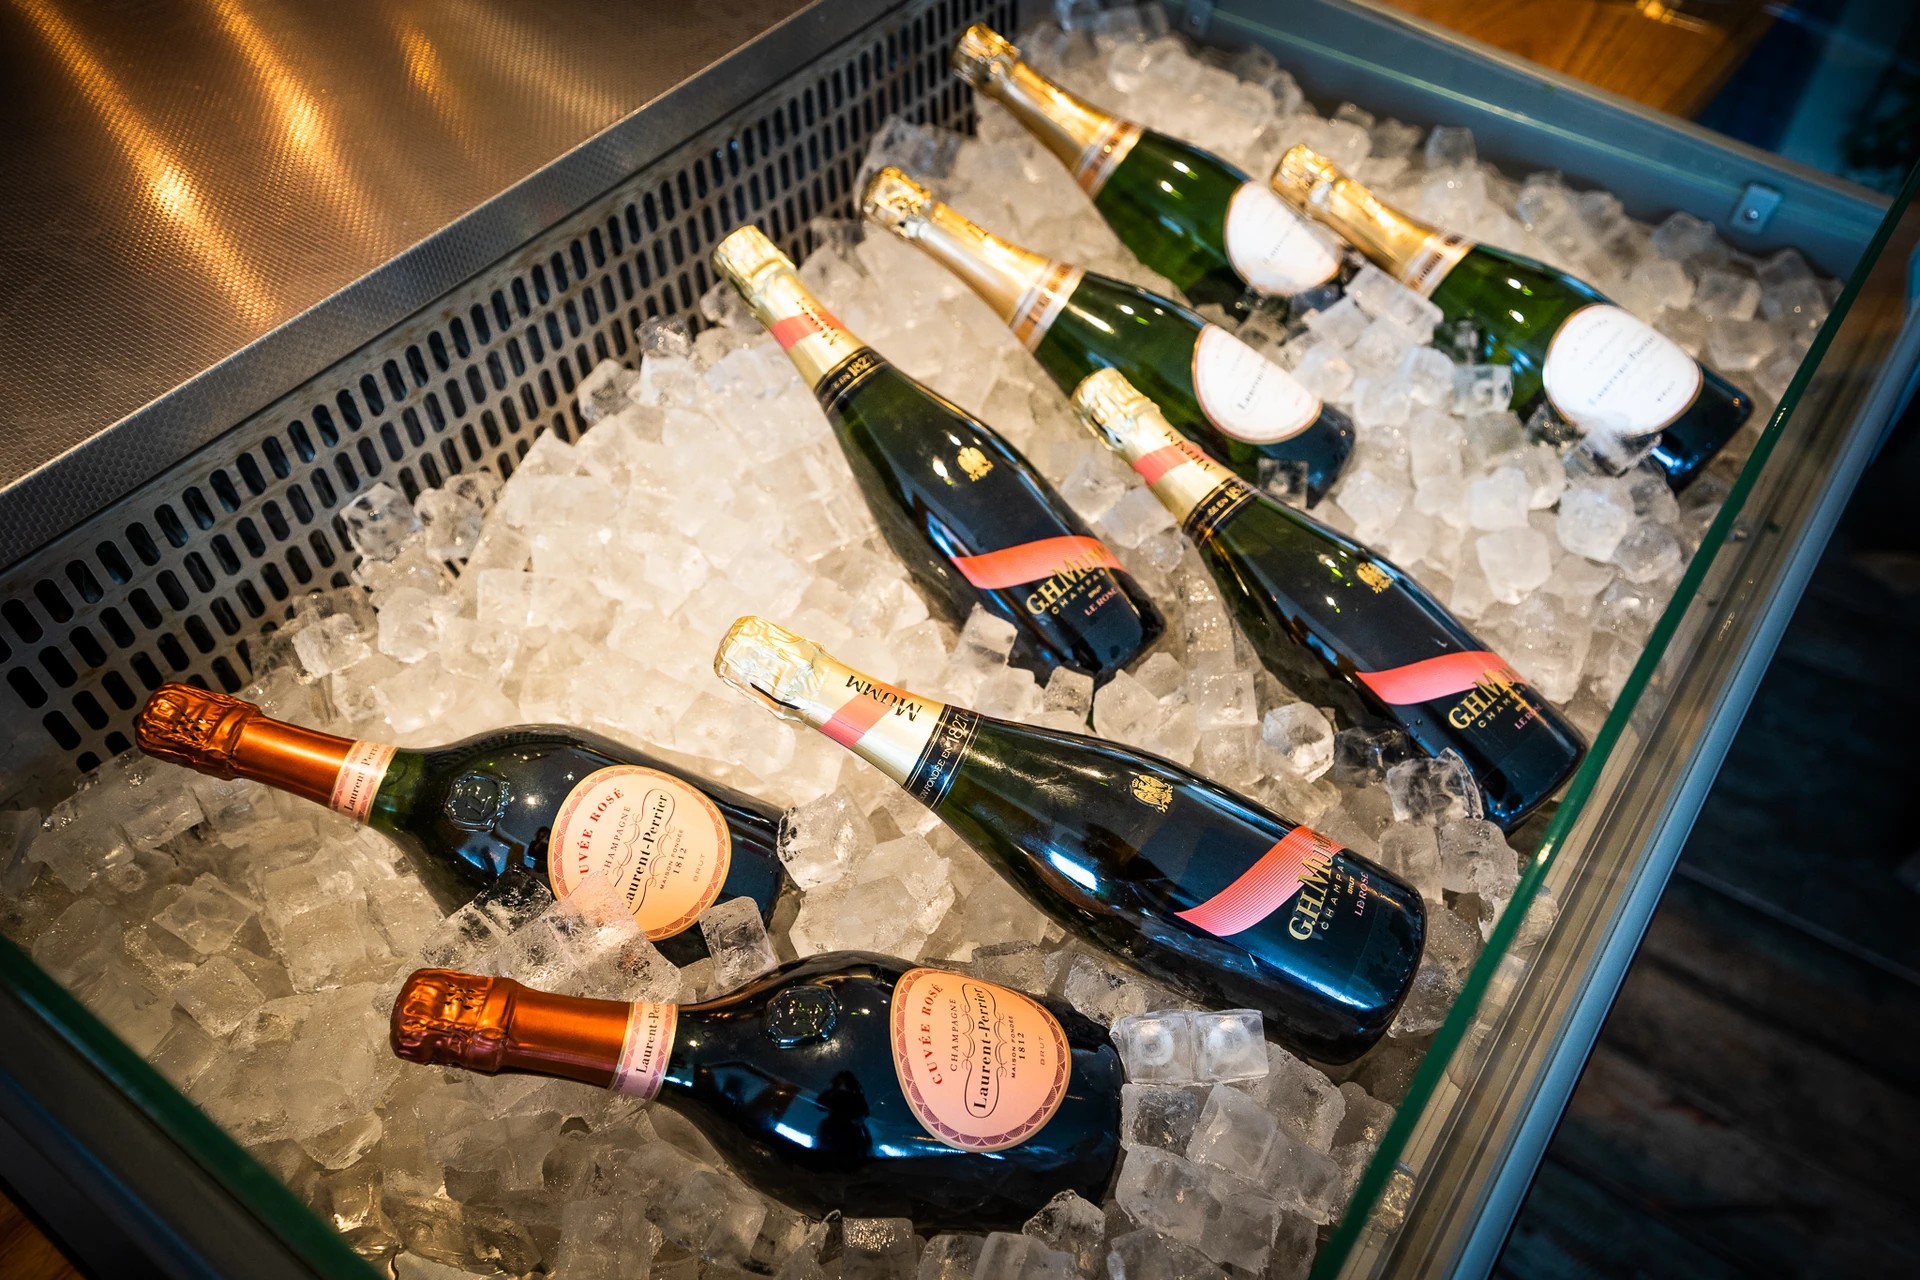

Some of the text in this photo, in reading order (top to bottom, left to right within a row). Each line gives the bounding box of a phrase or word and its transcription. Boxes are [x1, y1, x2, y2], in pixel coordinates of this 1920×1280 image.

[578, 787, 624, 876] UVÉE ROSÉ
[660, 860, 673, 890] MAISON
[673, 848, 687, 875] 1812
[692, 853, 706, 883] BRUT
[1347, 876, 1355, 895] BRUT
[918, 983, 944, 1085] CUVÉE ROSÉ
[949, 998, 959, 1072] CHAMPAGNE
[973, 987, 992, 1110] Laurent-Perrier
[1017, 1032, 1026, 1060] 1812
[1038, 1035, 1046, 1066] BRUT
